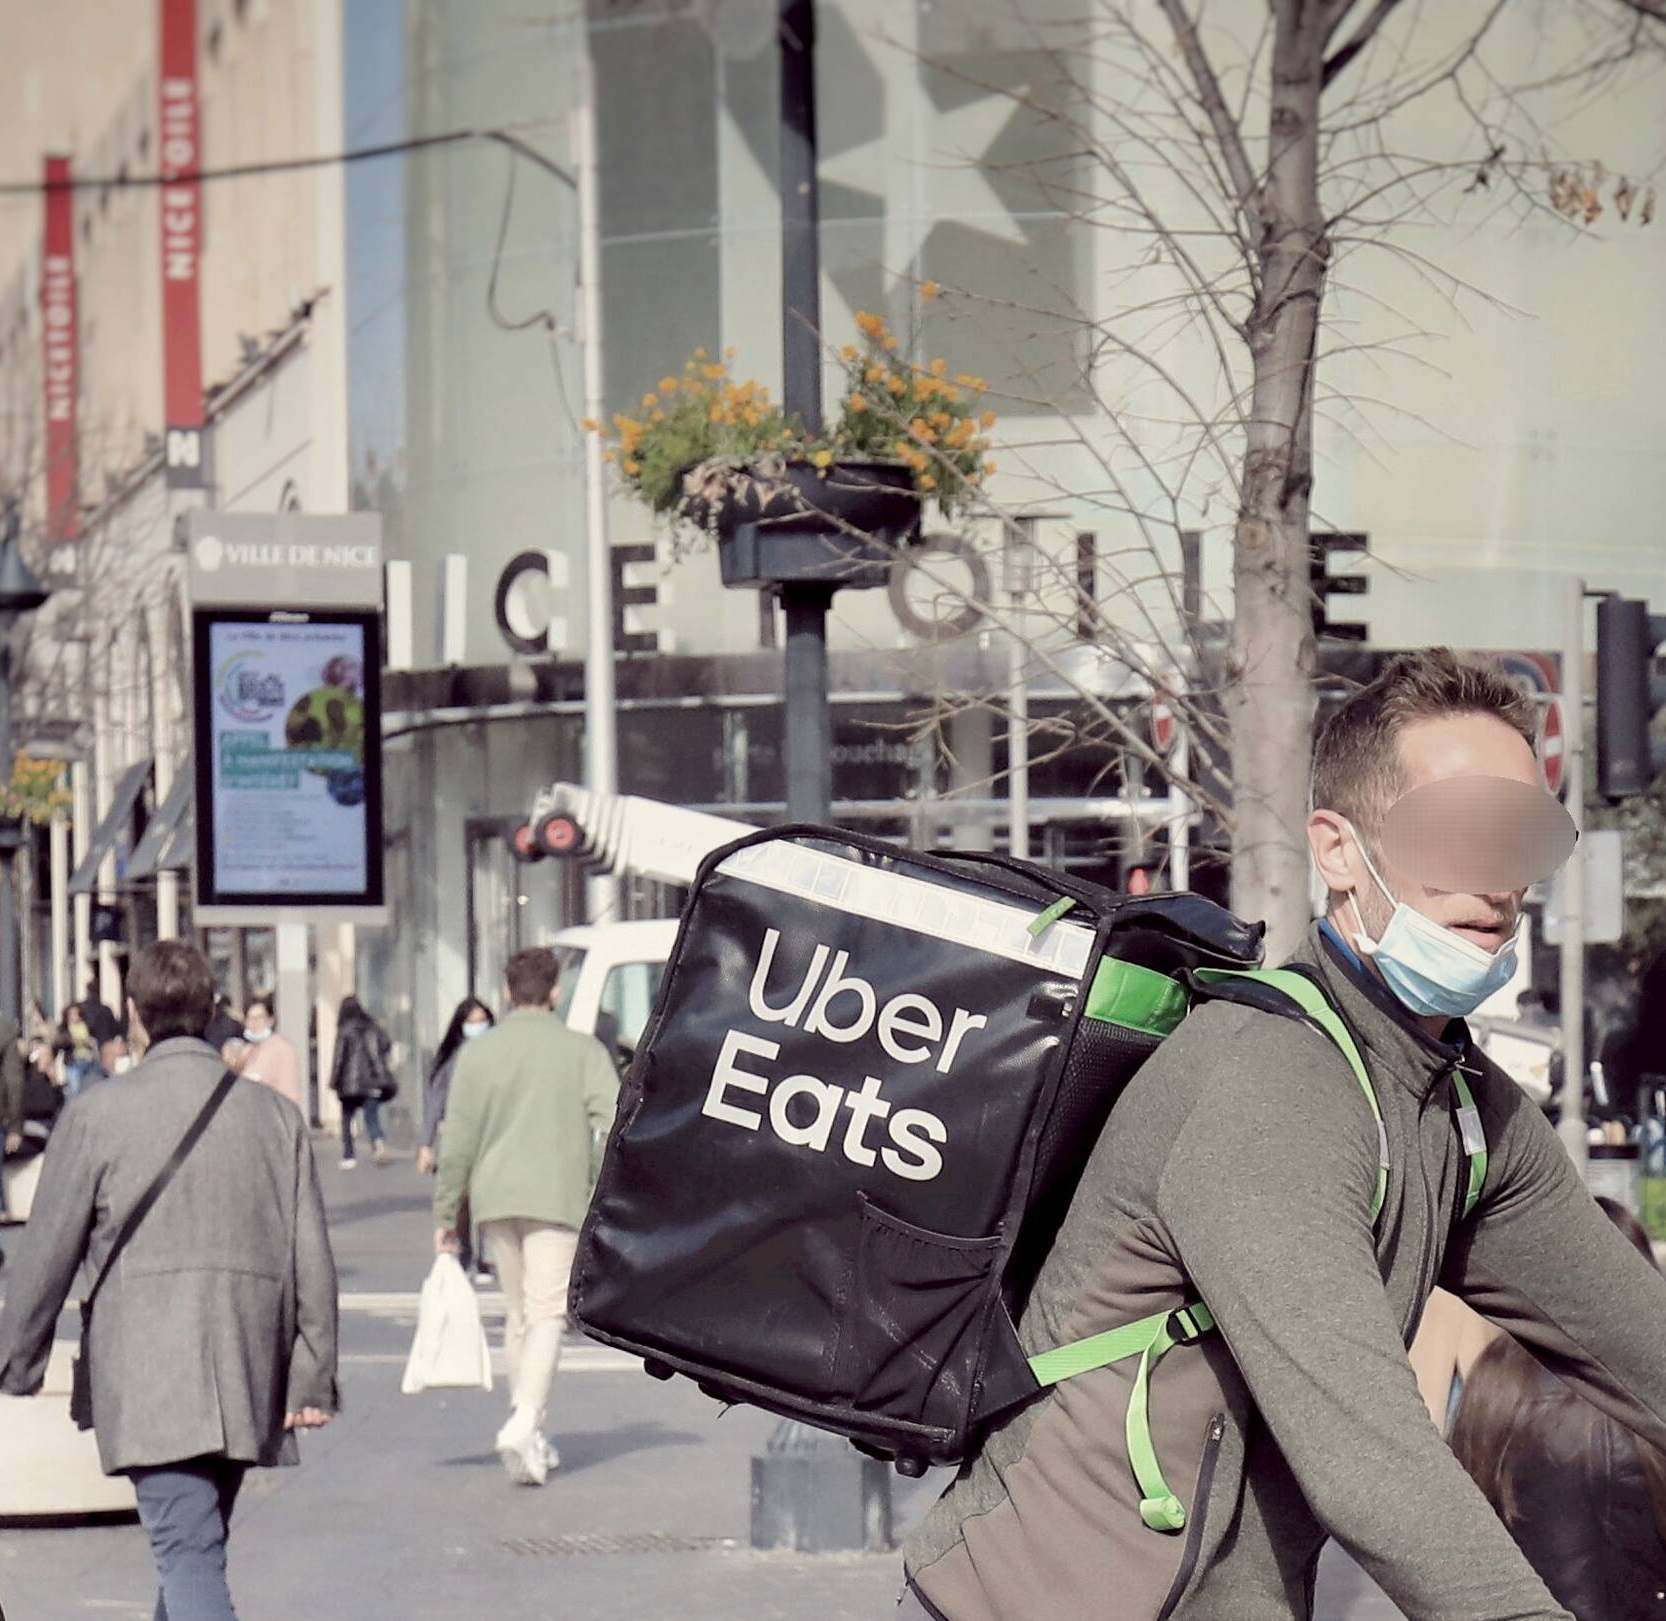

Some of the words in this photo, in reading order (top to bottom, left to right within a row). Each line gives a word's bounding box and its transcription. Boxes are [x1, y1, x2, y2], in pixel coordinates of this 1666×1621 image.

[226, 543, 283, 566] VILLE
[288, 544, 319, 567] DE
[323, 545, 376, 568] NICE
[746, 927, 988, 1075] Uber
[700, 1028, 948, 1182] Eats
